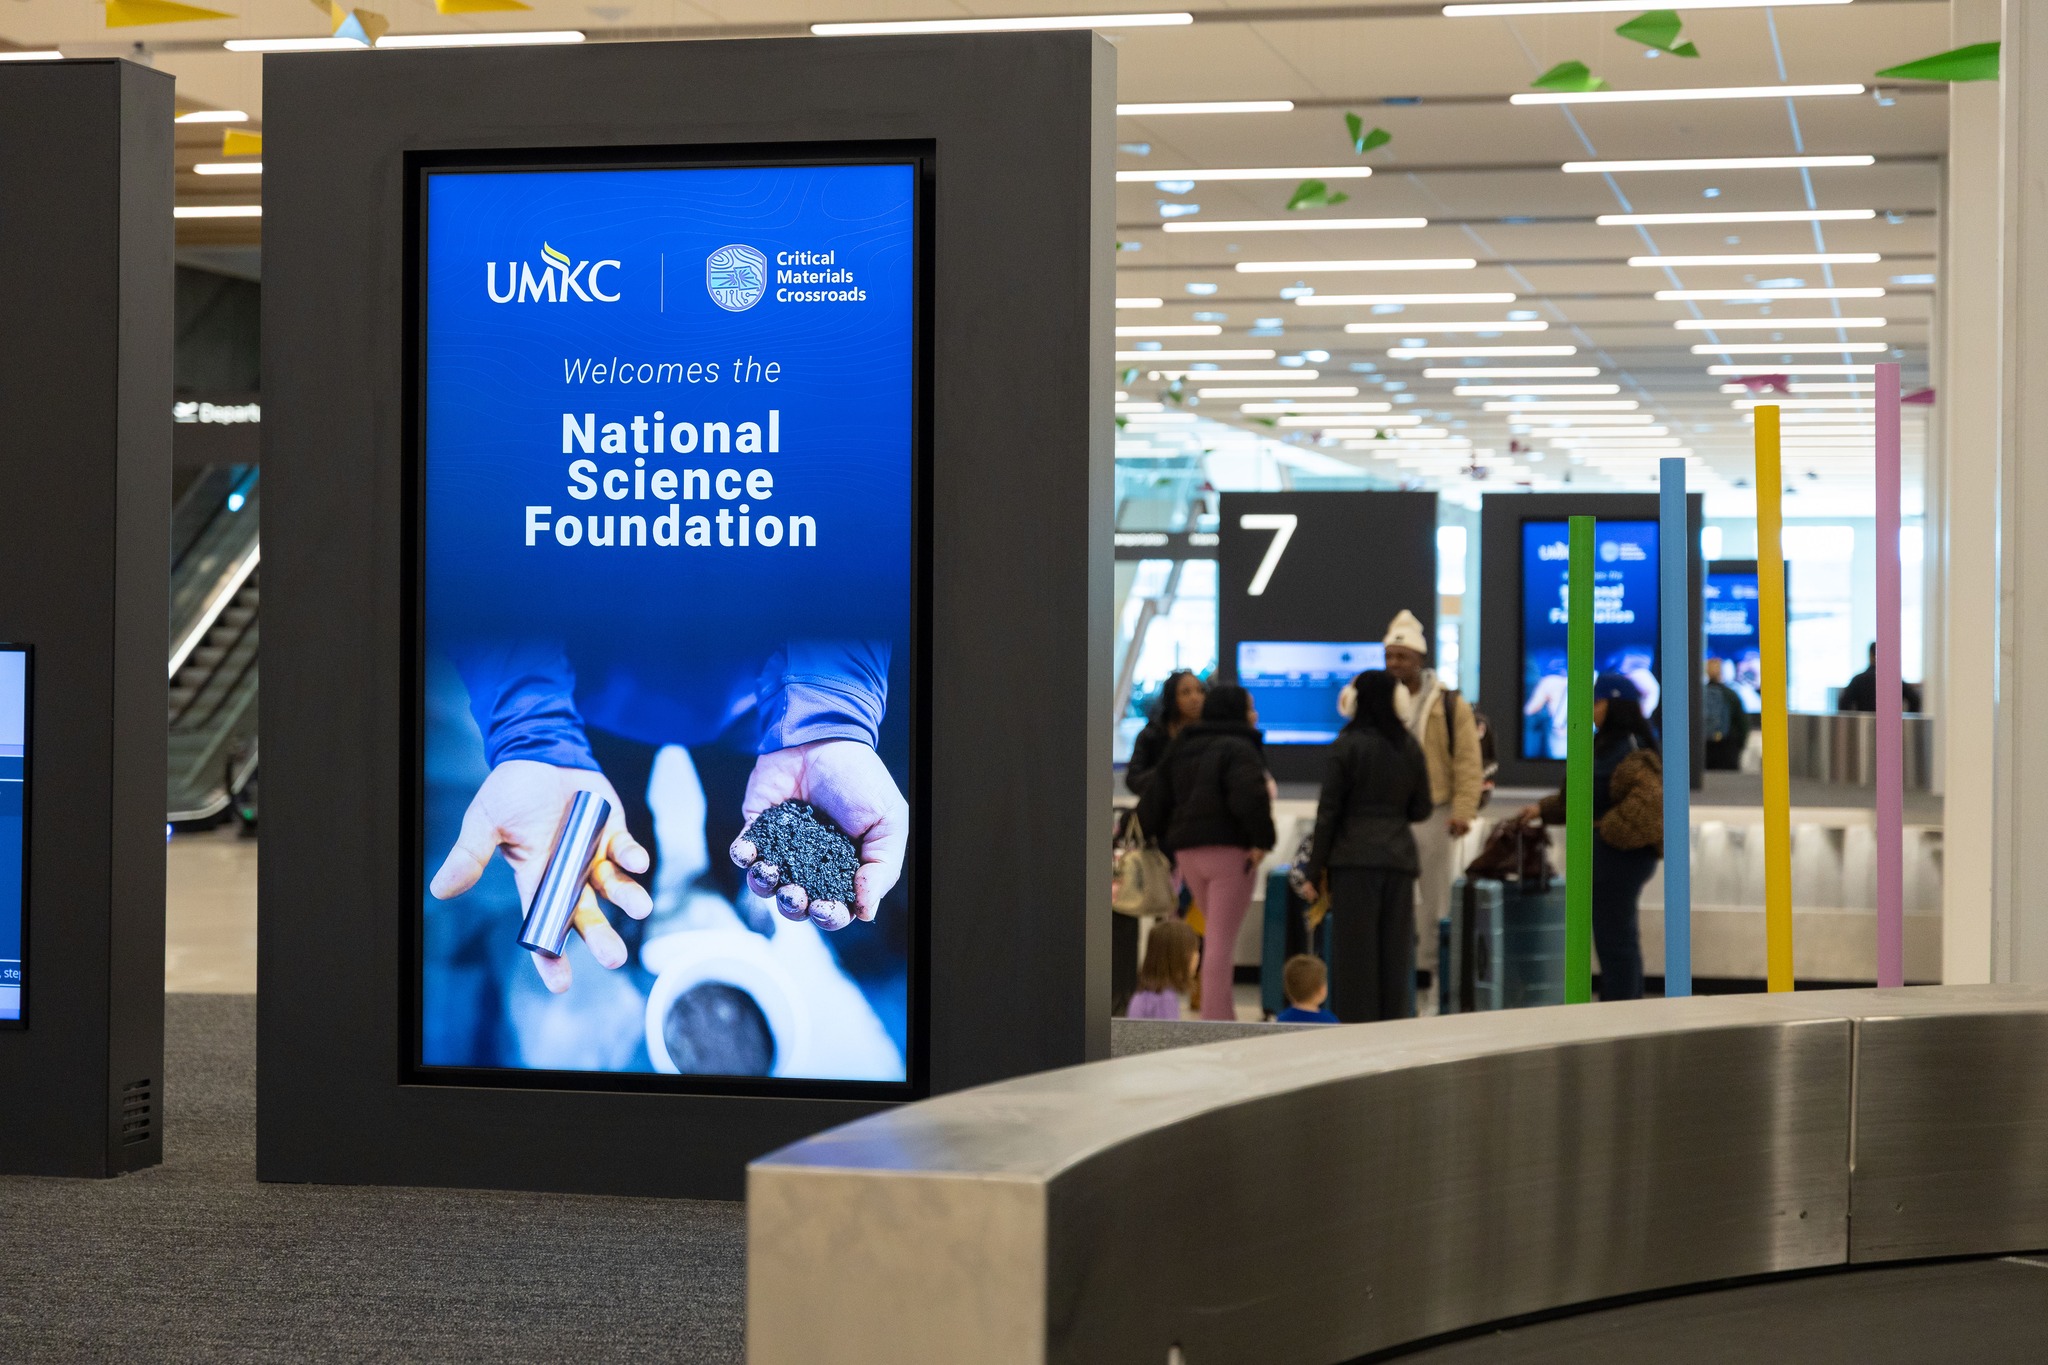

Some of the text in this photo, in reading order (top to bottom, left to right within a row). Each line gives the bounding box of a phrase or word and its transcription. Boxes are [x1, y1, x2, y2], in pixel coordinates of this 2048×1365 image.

[486, 250, 621, 303] UMKC
[776, 250, 835, 266] Critical
[776, 268, 854, 284] Materials
[776, 286, 867, 303] Crossroads
[563, 355, 782, 385] Welcomes the
[562, 409, 781, 454] National
[567, 457, 775, 501] Science
[524, 503, 817, 547] Foundation
[1239, 513, 1298, 596] 7
